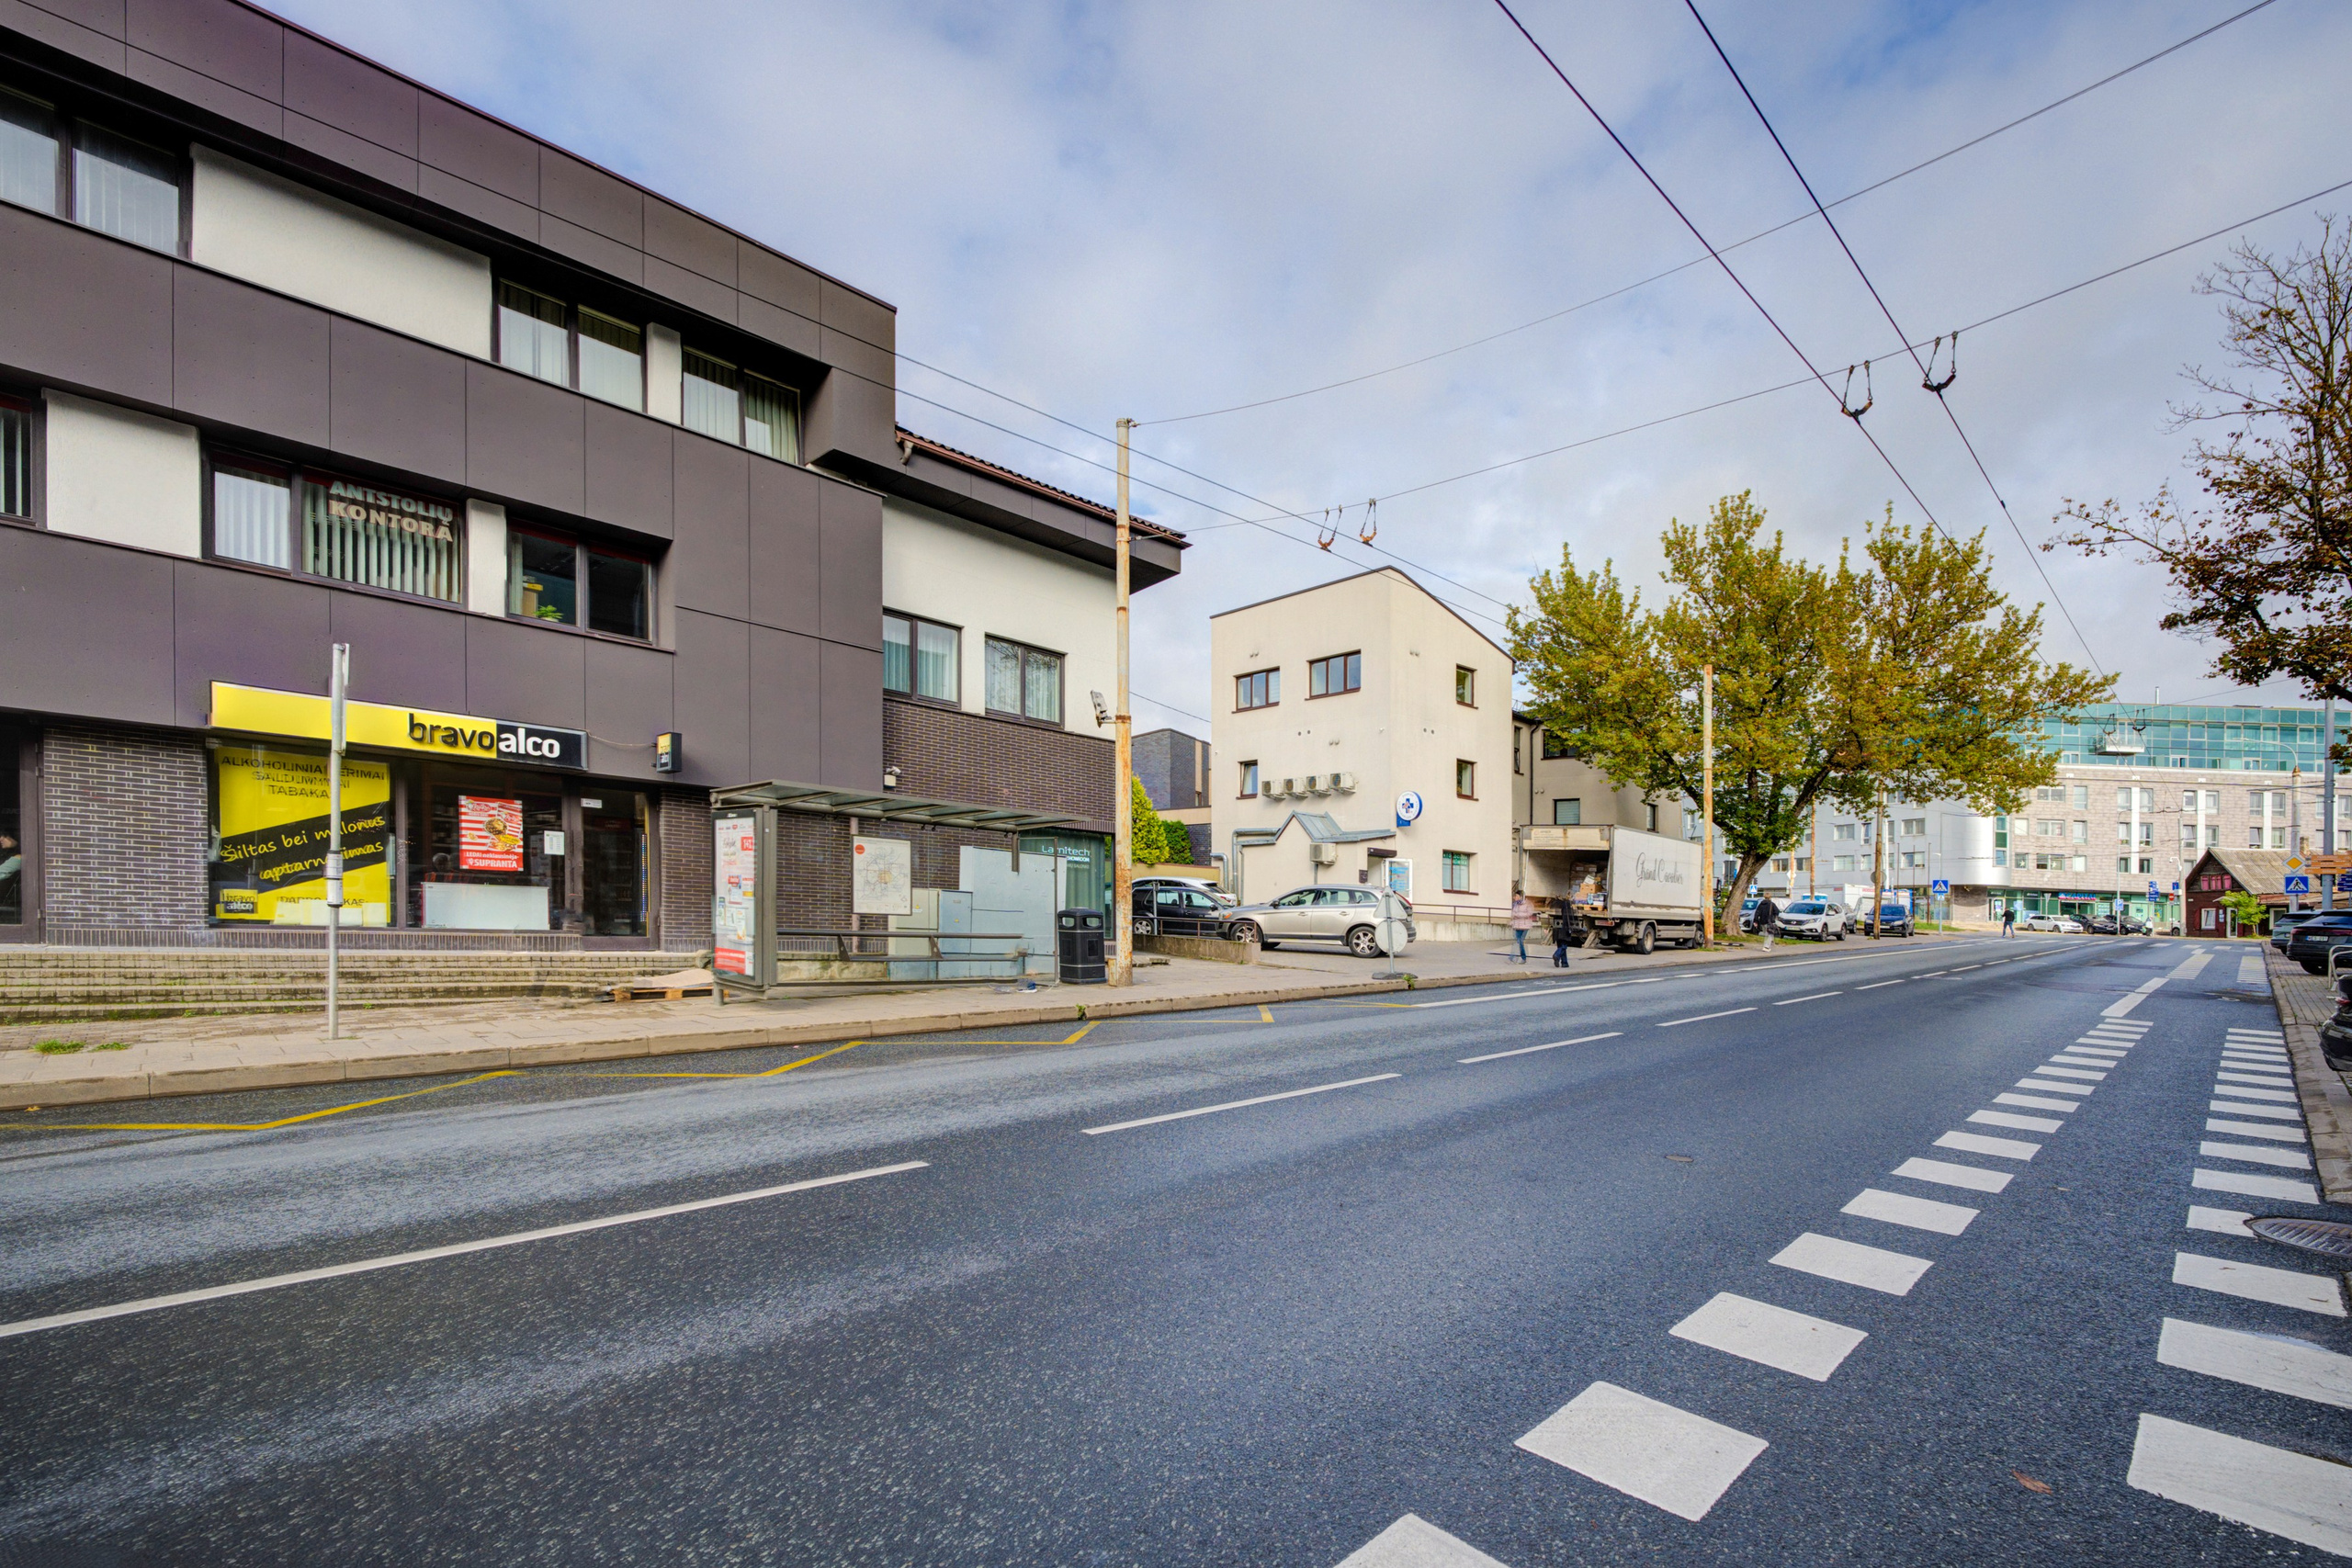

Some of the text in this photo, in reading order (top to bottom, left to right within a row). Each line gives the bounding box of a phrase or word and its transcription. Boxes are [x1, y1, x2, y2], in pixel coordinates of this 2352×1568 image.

[328, 500, 453, 542] KONTORA
[329, 479, 453, 526] ANTSTOLIŲ
[340, 765, 386, 781] ĖRIMAI
[220, 816, 386, 863] Šiltas bei mlonus
[474, 859, 518, 868] SUPRANTA
